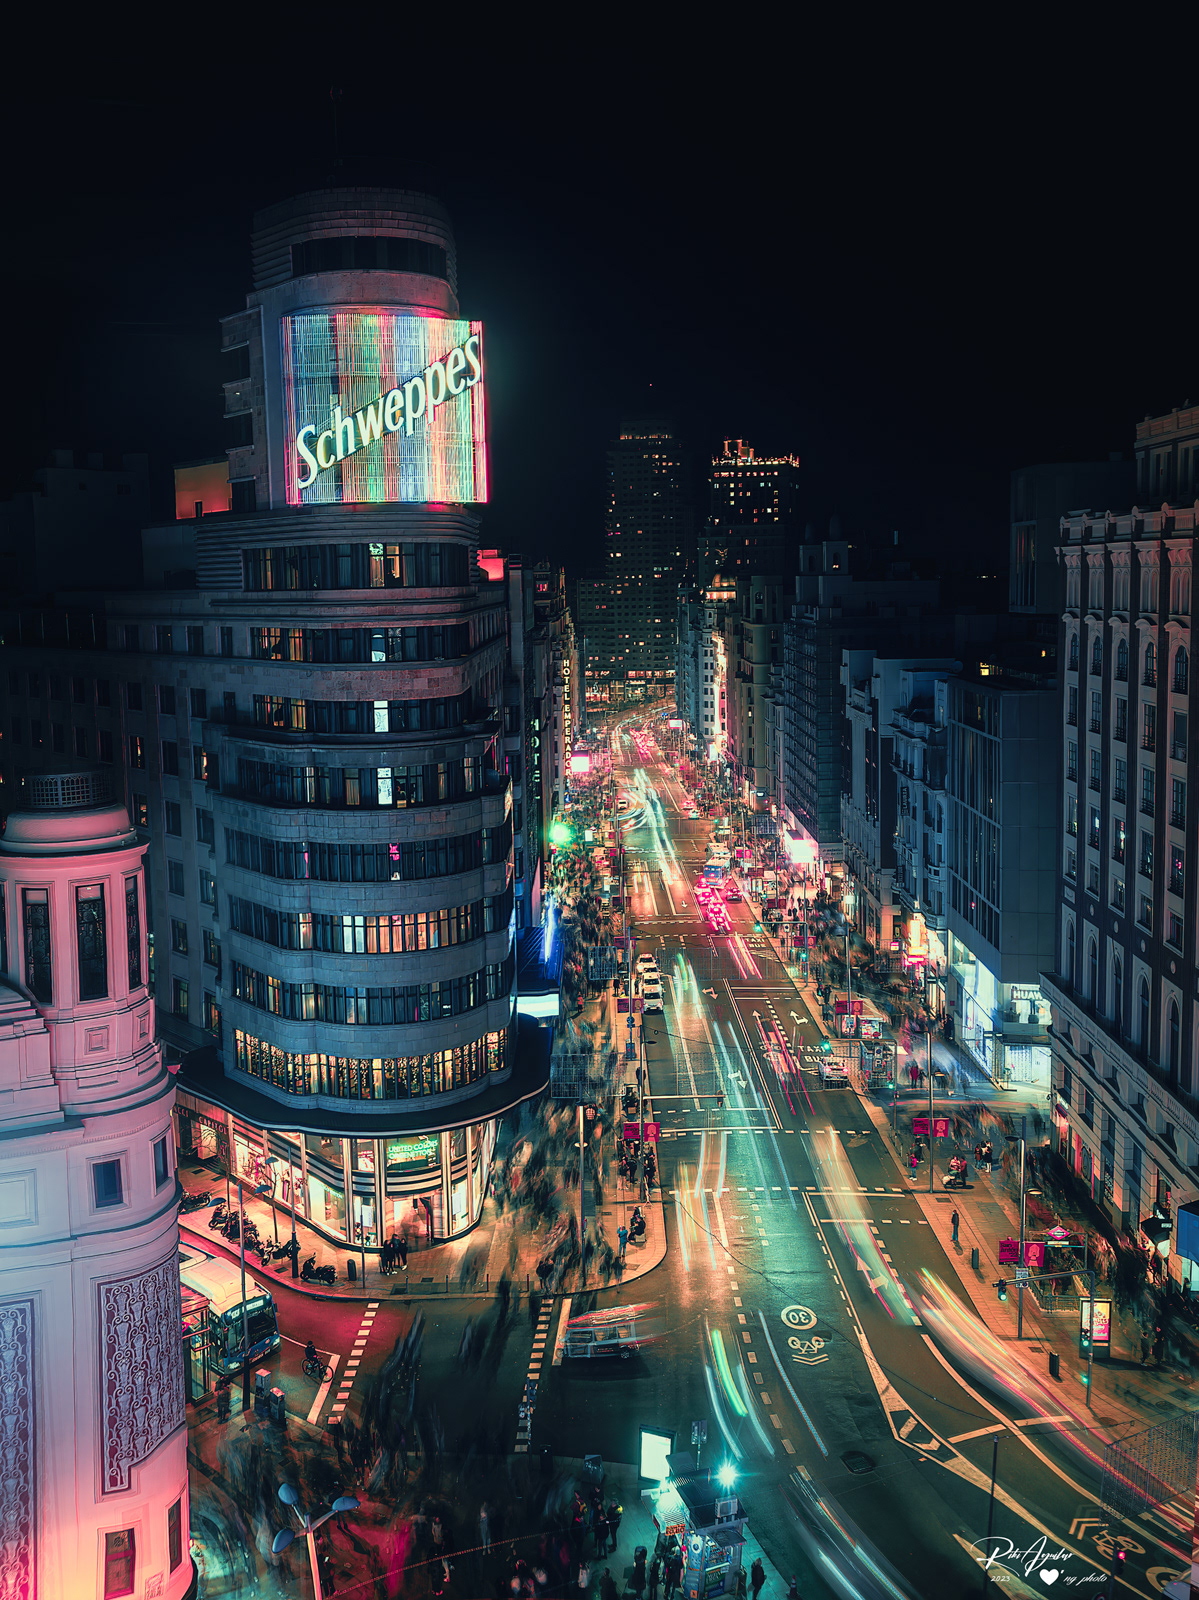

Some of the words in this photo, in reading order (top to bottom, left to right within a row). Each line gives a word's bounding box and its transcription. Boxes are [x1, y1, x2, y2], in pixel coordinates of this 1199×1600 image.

[296, 335, 481, 489] Schweppes
[563, 660, 571, 700] HOTEL
[564, 704, 572, 776] EMPERADOR
[797, 1045, 826, 1053] TAXI
[804, 1055, 823, 1063] BU
[199, 1116, 228, 1135] CAPITOL
[388, 1144, 413, 1153] UNITED
[789, 1311, 809, 1324] 30
